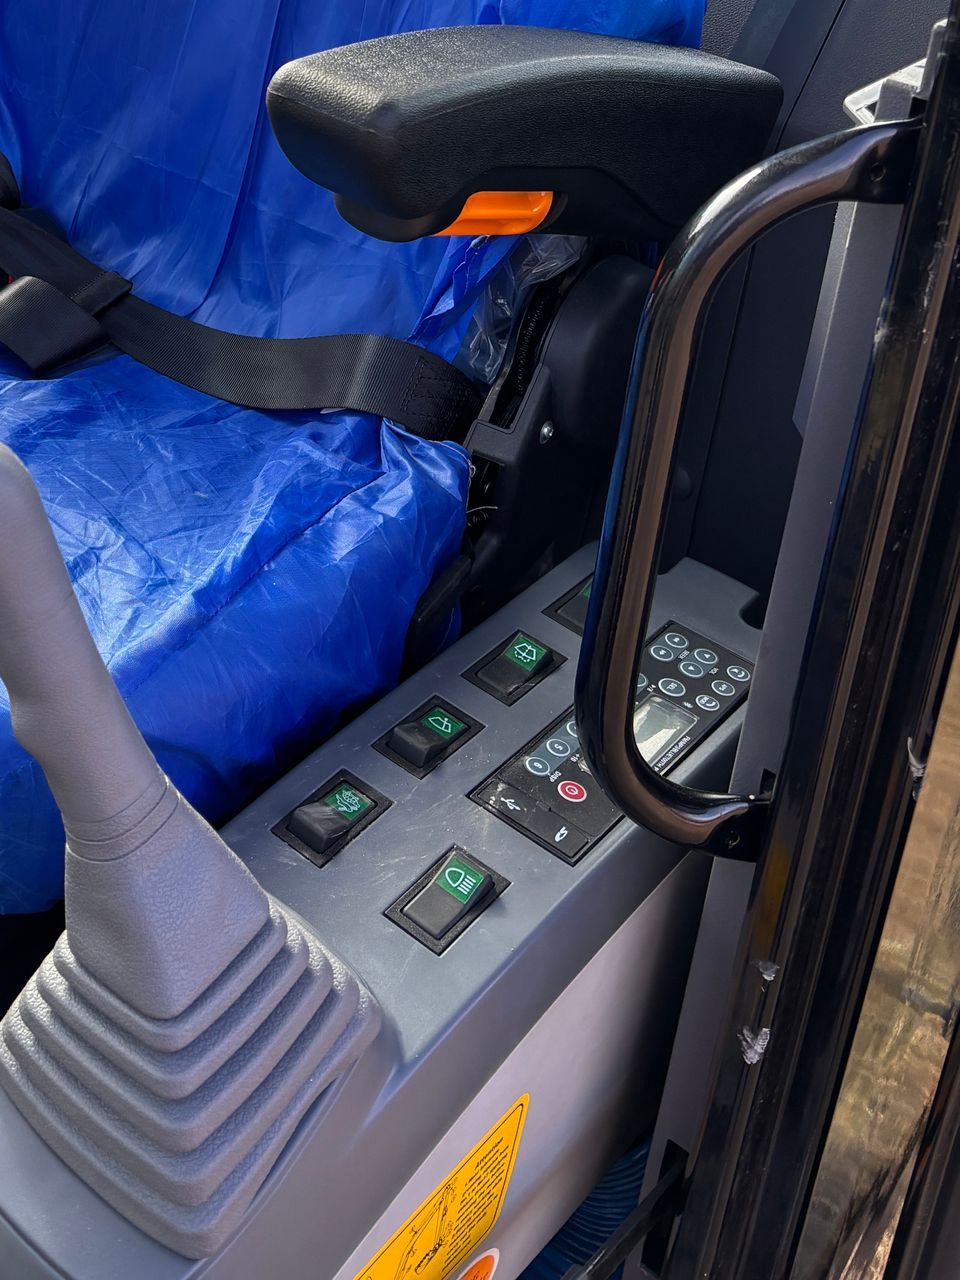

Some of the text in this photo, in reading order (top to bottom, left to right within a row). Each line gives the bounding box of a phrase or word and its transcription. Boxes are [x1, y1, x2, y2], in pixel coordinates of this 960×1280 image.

[678, 650, 690, 660] SEEK
[708, 667, 720, 676] VOL
[668, 682, 678, 691] SEL
[549, 770, 562, 783] DISP
